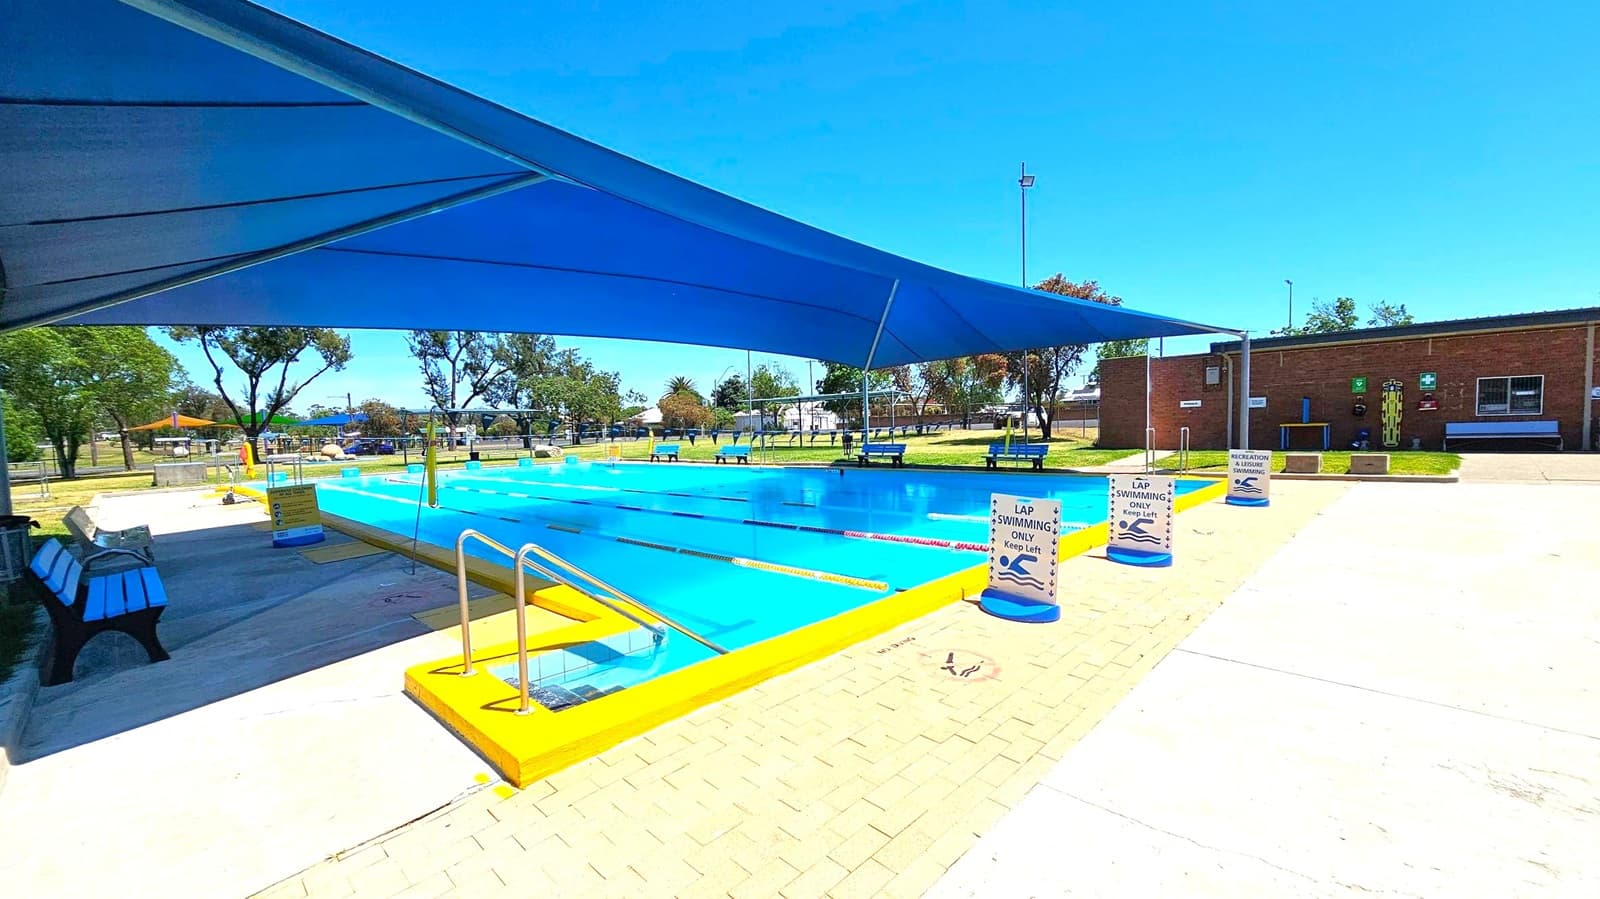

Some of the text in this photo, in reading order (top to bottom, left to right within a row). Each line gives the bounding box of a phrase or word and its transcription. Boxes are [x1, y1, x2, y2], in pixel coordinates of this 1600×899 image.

[1231, 453, 1269, 461] RECREATION
[1232, 467, 1266, 475] SWIMMING
[1132, 481, 1150, 490] LAP
[1116, 489, 1166, 501] SWIMMING
[1014, 504, 1034, 516] LAP
[1129, 501, 1151, 509] ONLY
[1123, 509, 1157, 518] Keep Left
[997, 514, 1051, 533] SWIMMING
[1011, 530, 1035, 543] ONLY
[1004, 540, 1042, 555] Keep Left
